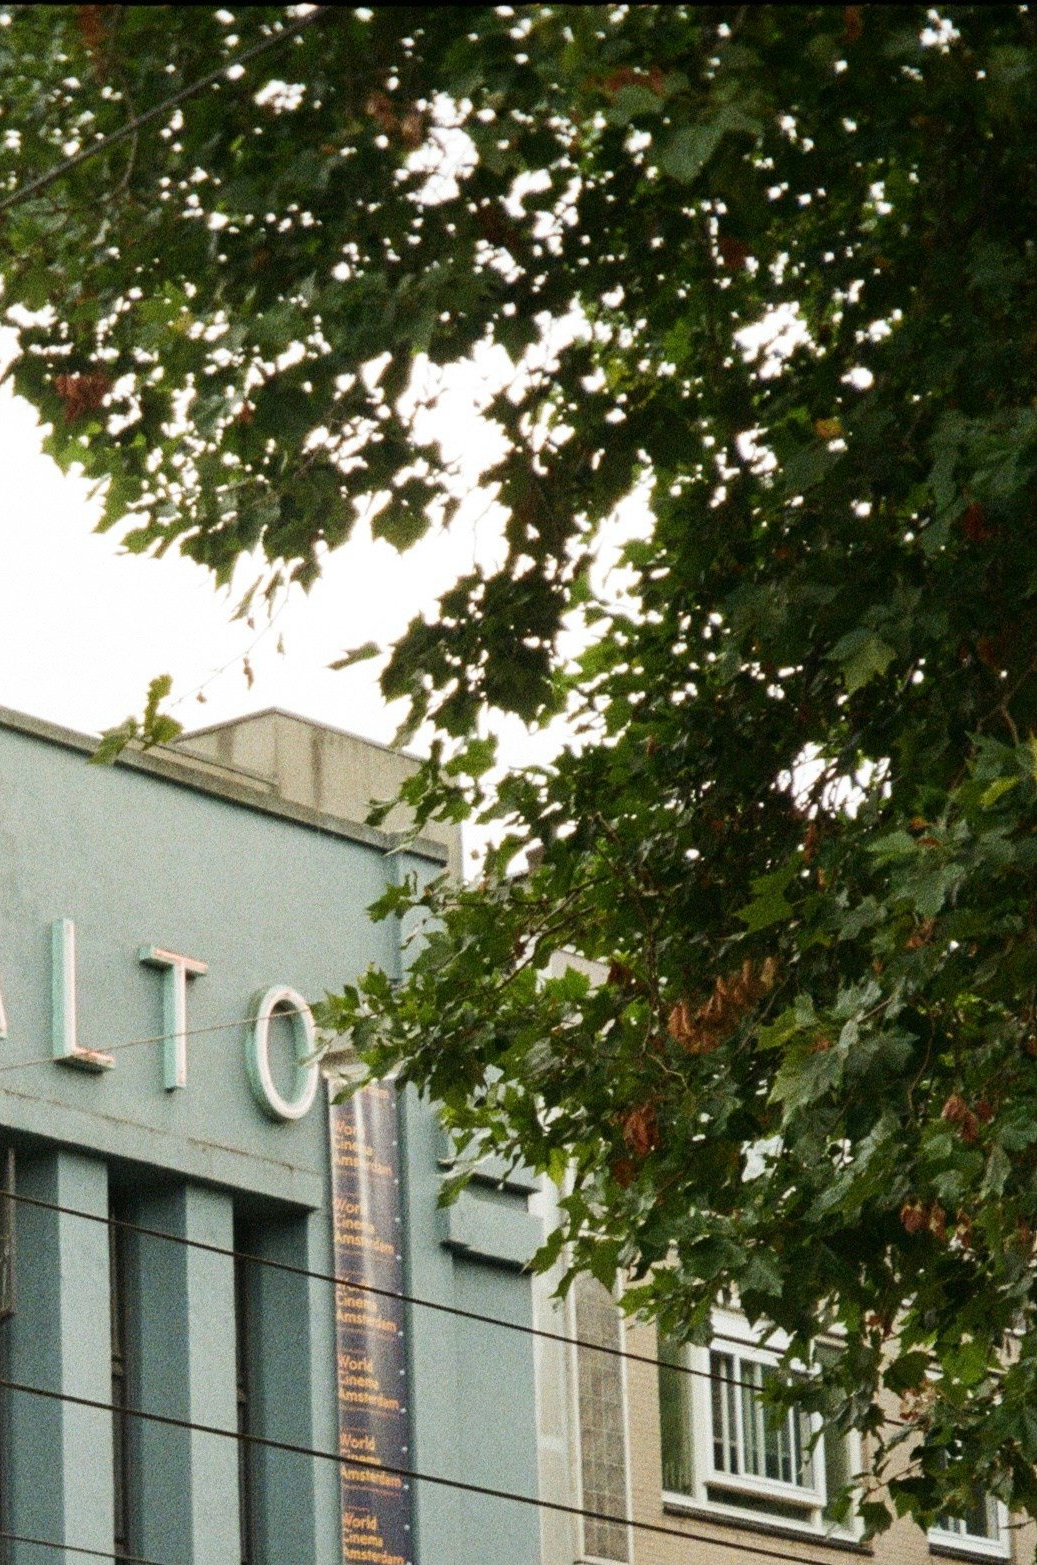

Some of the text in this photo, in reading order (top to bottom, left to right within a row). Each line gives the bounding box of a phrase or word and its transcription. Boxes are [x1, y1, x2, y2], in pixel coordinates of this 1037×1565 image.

[340, 1433, 376, 1451] World
[340, 1466, 402, 1488] Amsterdam
[342, 1511, 377, 1531] World
